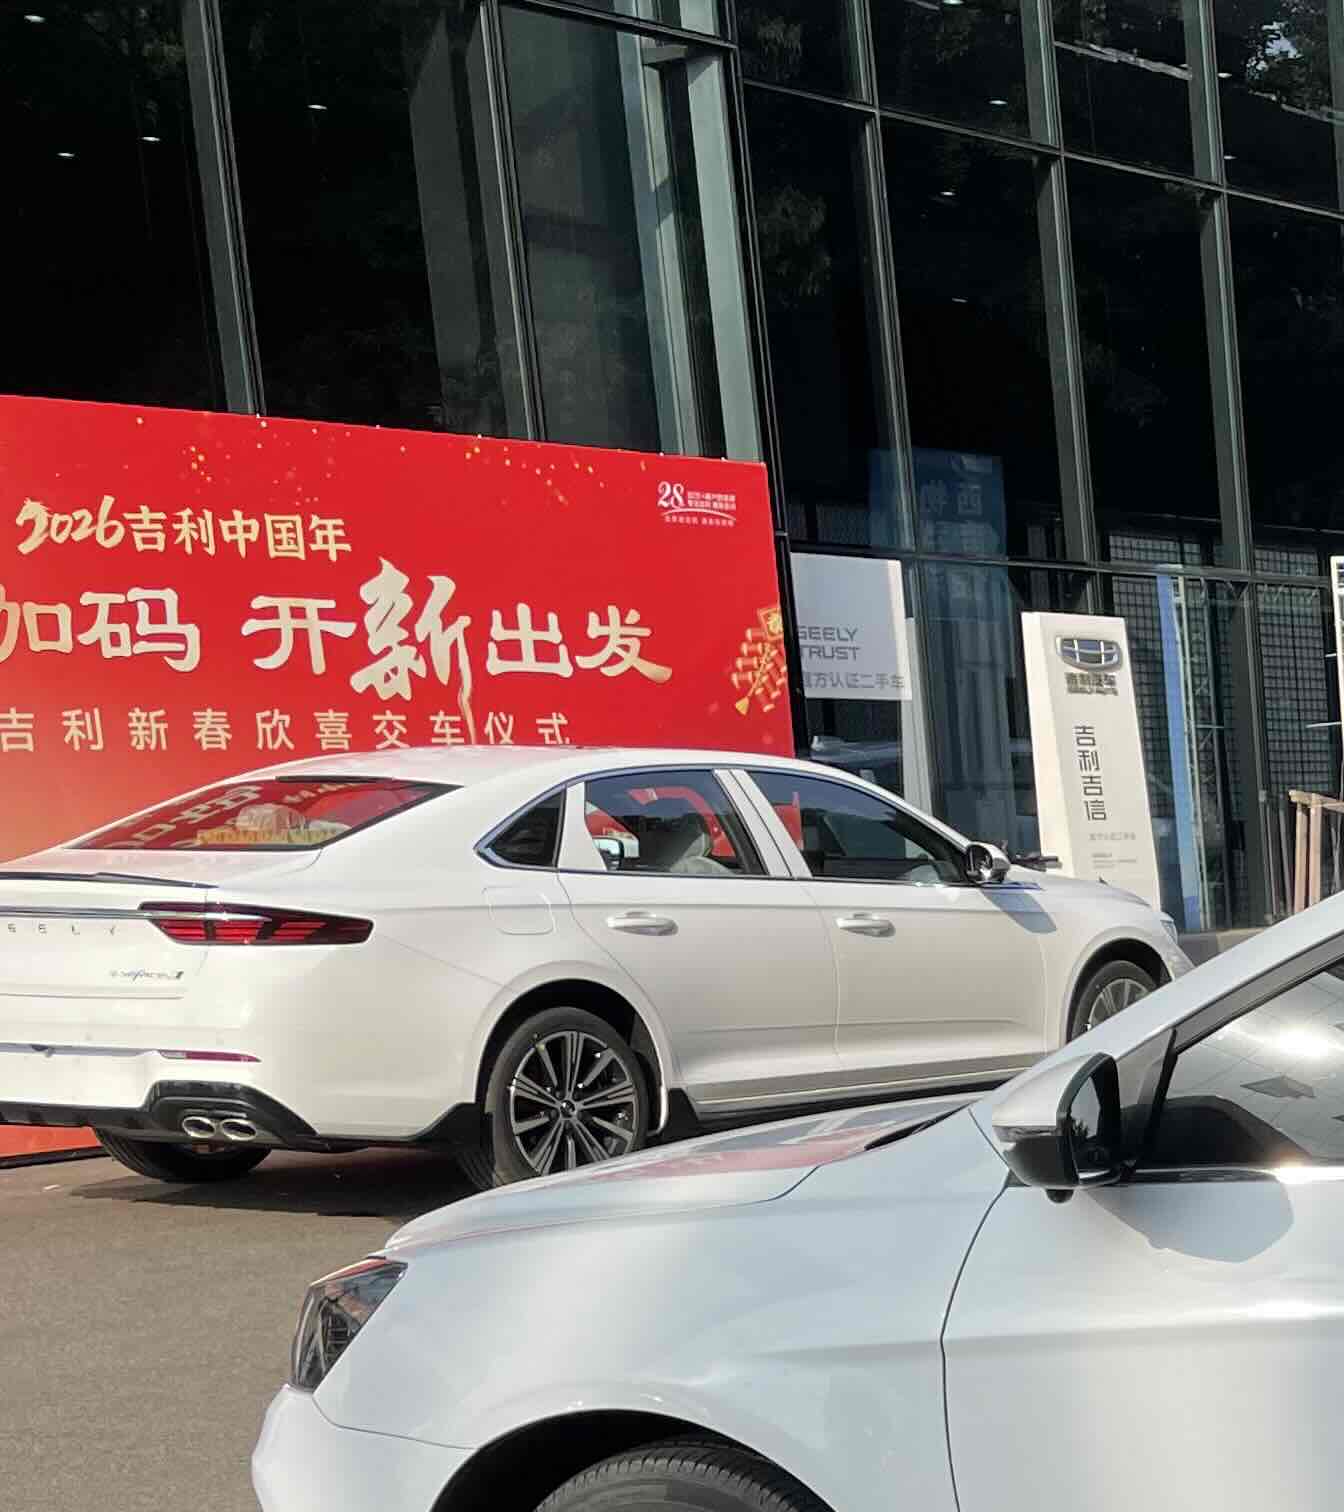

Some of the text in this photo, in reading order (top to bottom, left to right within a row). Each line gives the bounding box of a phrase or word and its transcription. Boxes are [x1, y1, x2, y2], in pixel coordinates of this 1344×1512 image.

[657, 480, 685, 508] 28
[15, 495, 352, 562] 2026吉利中国年
[241, 557, 673, 742] 开新出发
[799, 624, 858, 642] GEELY
[800, 643, 860, 661] TRUST
[0, 709, 571, 752] 吉利新春欣喜交车仪式
[1074, 725, 1107, 821] 吉利吉信
